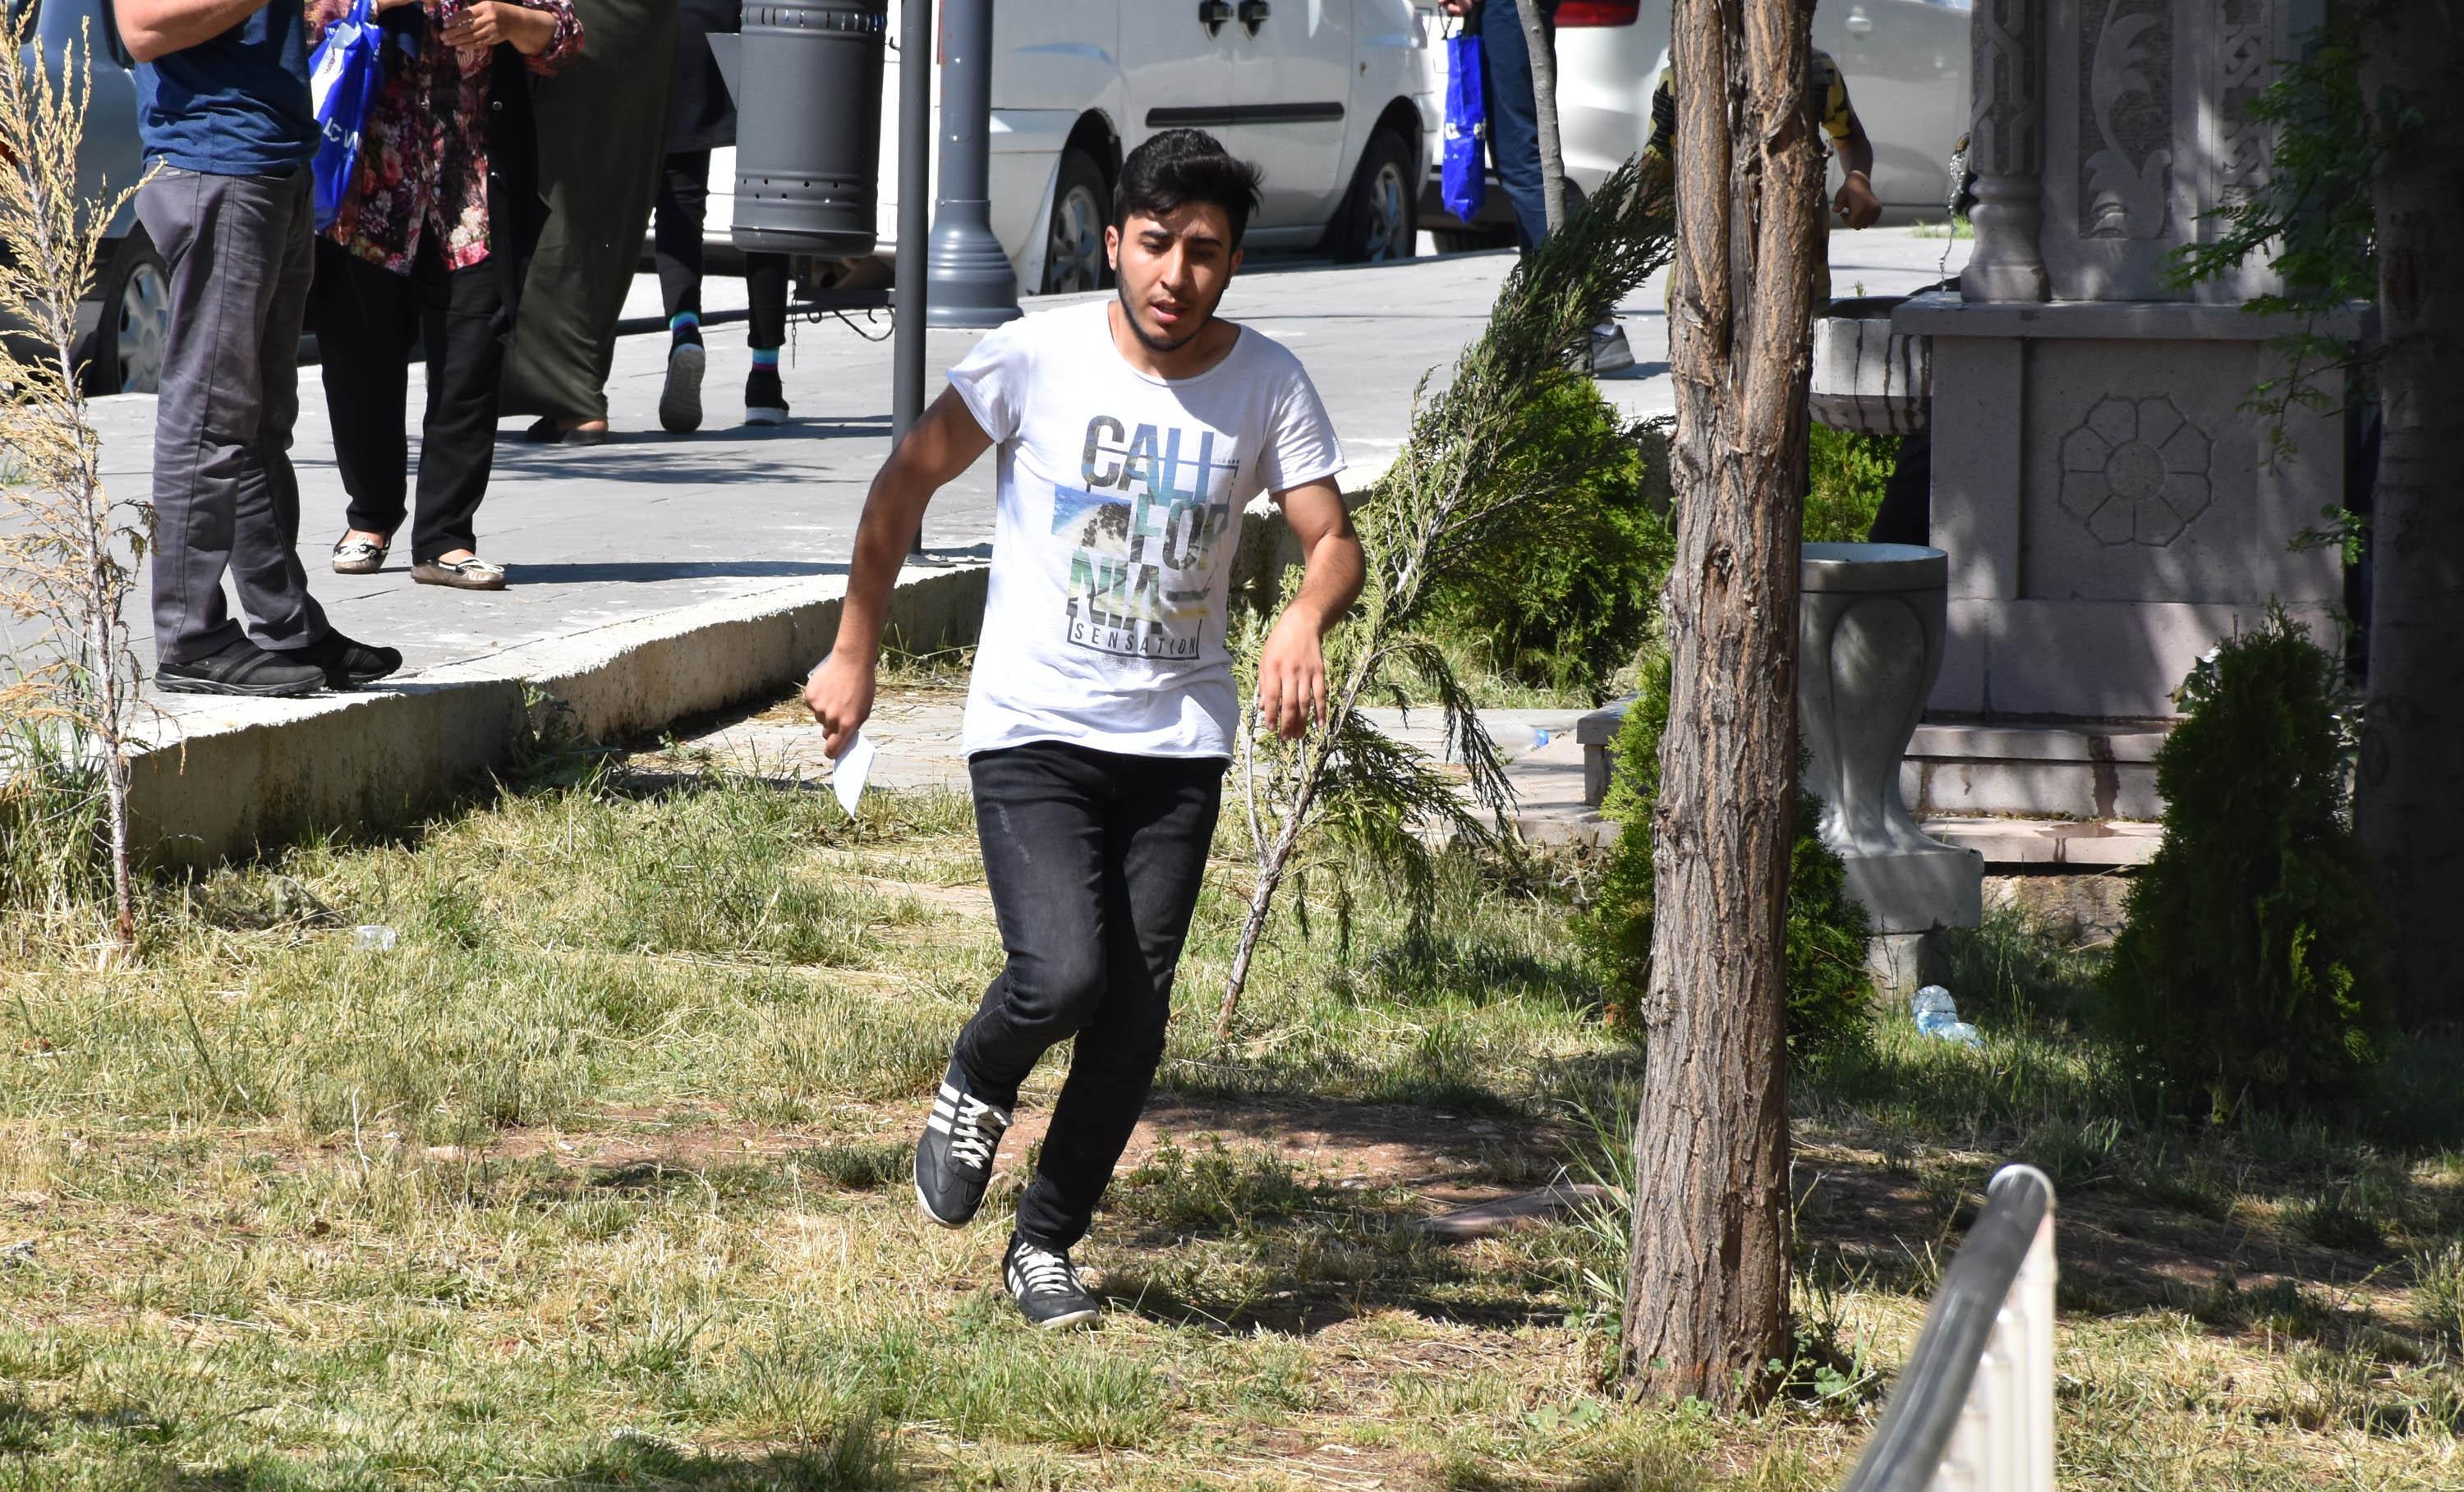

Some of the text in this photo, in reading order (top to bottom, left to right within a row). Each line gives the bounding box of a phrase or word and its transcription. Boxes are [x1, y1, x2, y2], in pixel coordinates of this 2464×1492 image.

[1081, 415, 1214, 507] CALI
[1066, 547, 1163, 635] NIA
[1074, 622, 1197, 654] SENSATION
